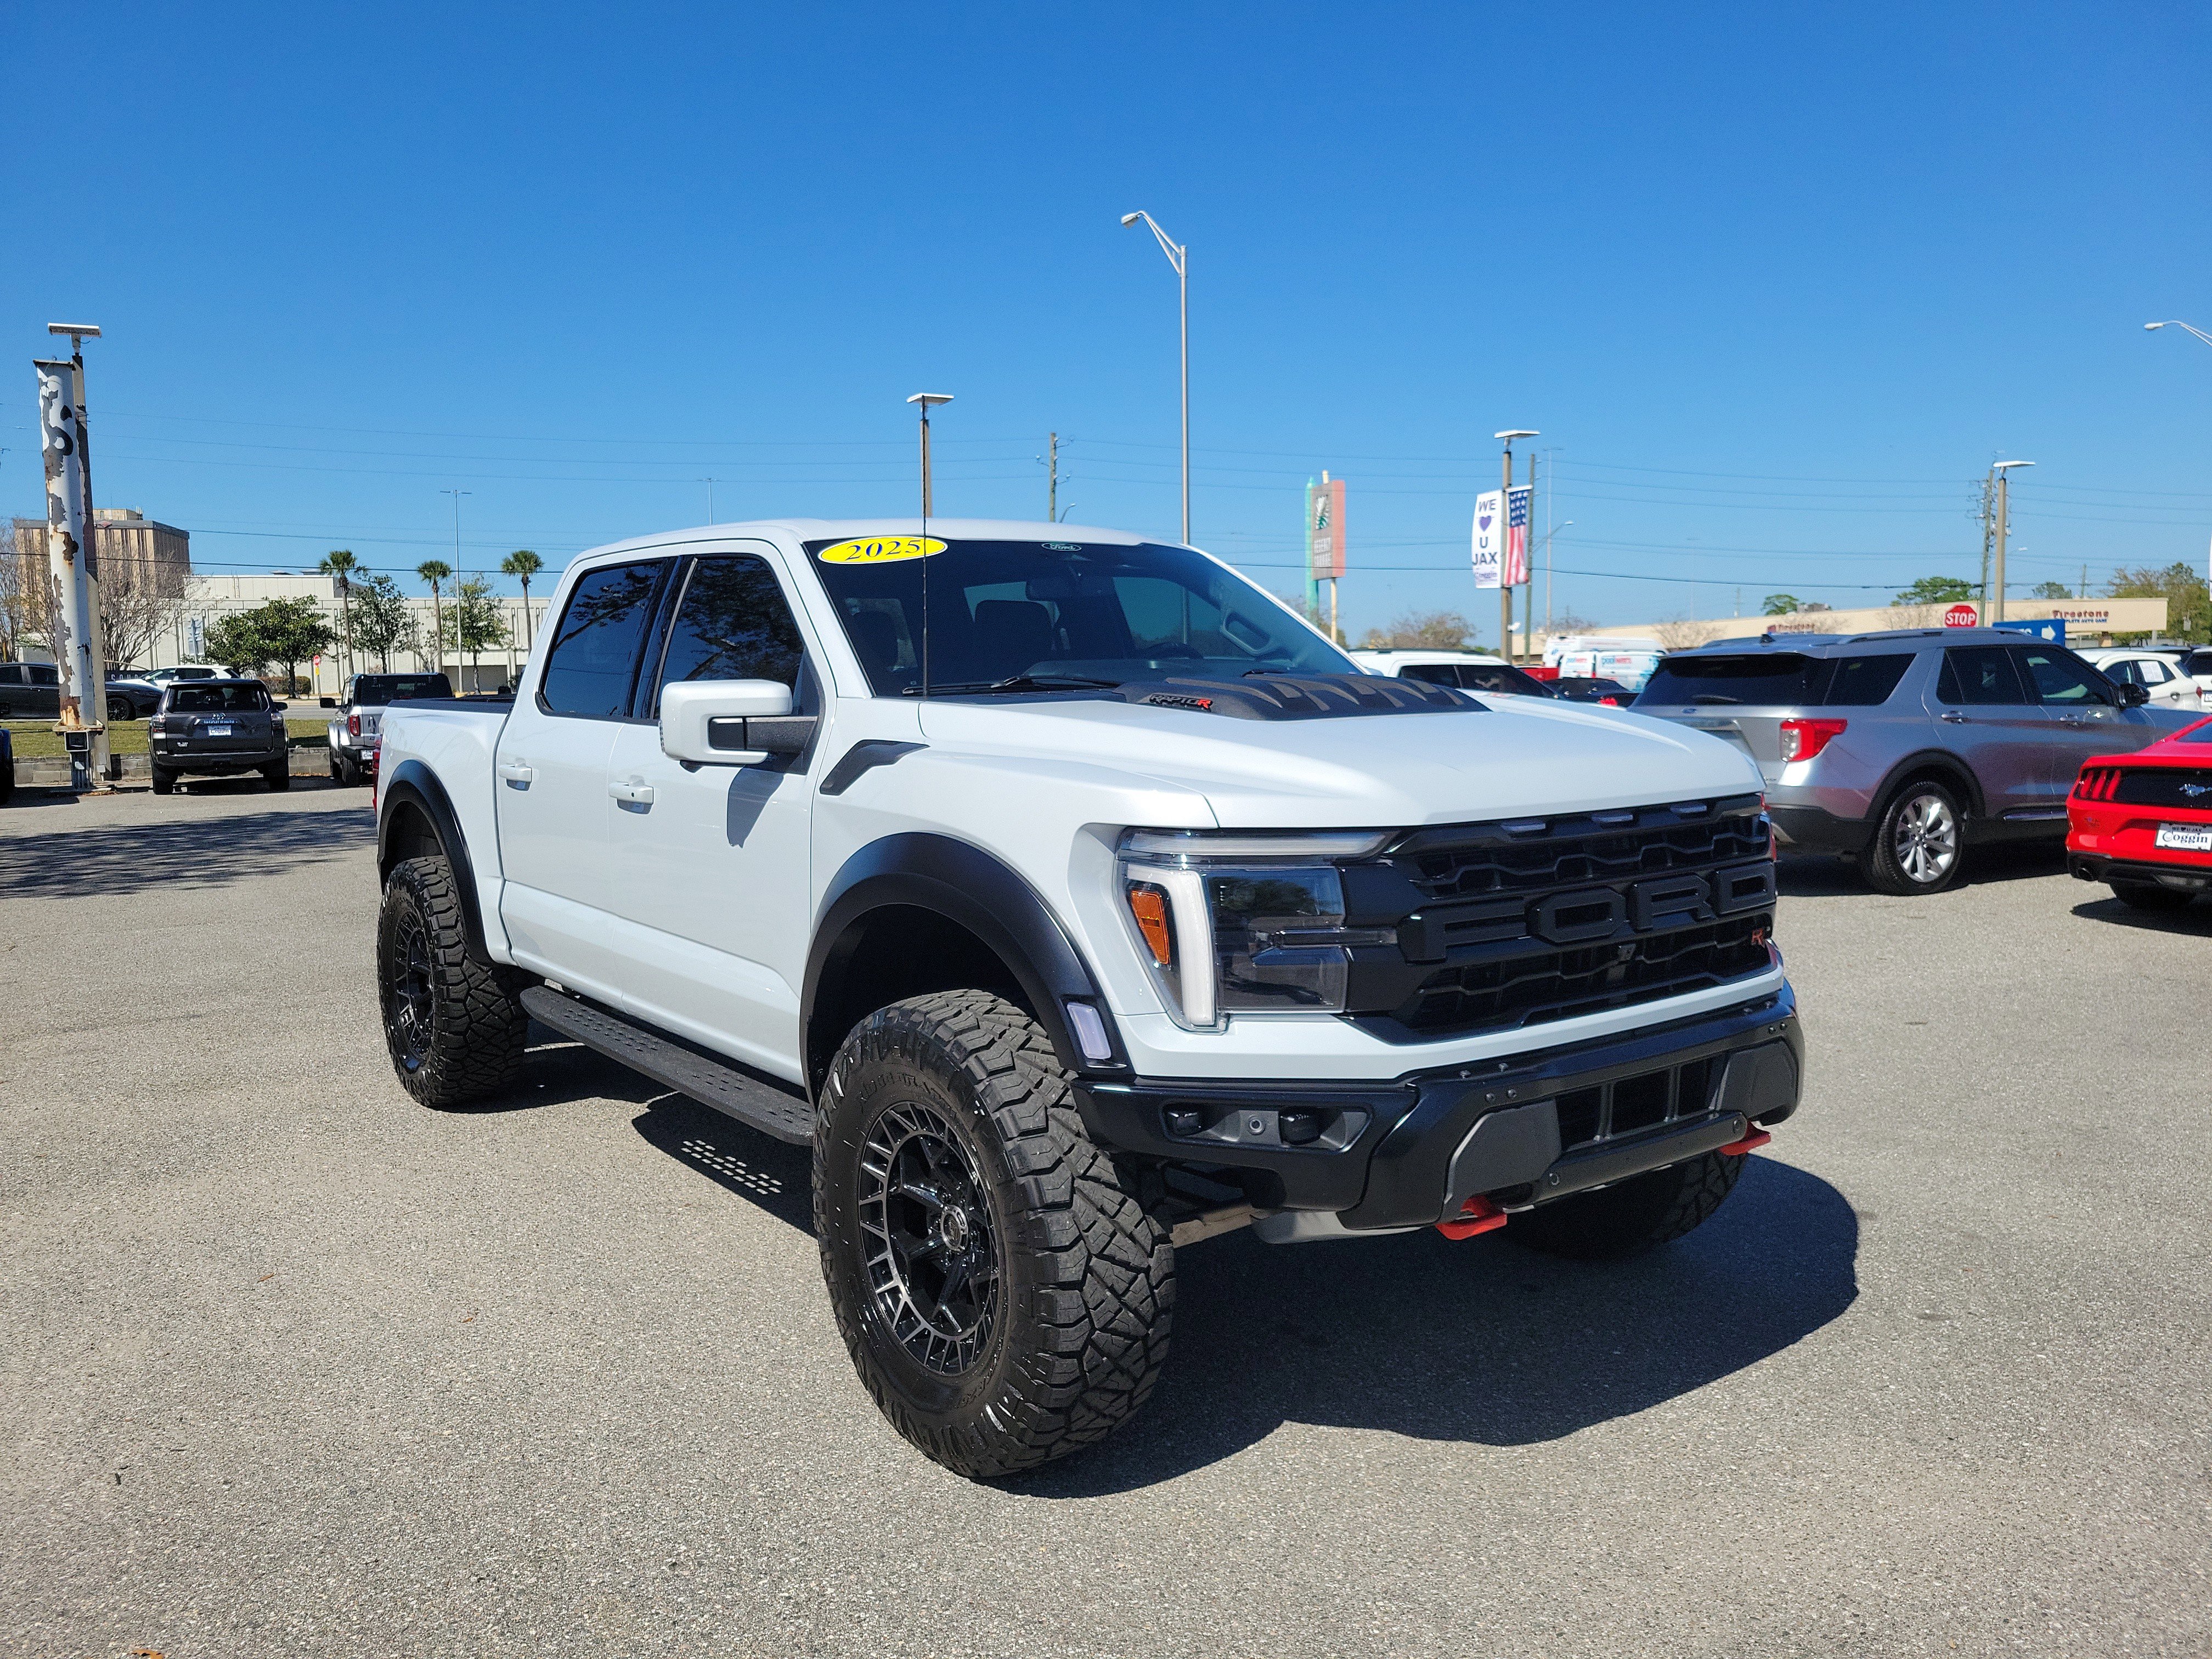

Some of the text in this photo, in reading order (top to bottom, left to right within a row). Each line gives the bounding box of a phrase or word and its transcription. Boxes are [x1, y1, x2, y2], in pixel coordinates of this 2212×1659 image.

[1478, 499, 1497, 512] WE
[1479, 536, 1488, 548] U
[845, 539, 921, 561] 2025
[1472, 551, 1498, 566] JAX
[1946, 612, 1976, 625] STOP
[2052, 610, 2108, 618] Firestone
[1149, 694, 1214, 710] RAPTOR
[2162, 831, 2208, 844] Coggin
[1397, 861, 1776, 966] FORD
[1751, 927, 1765, 947] R
